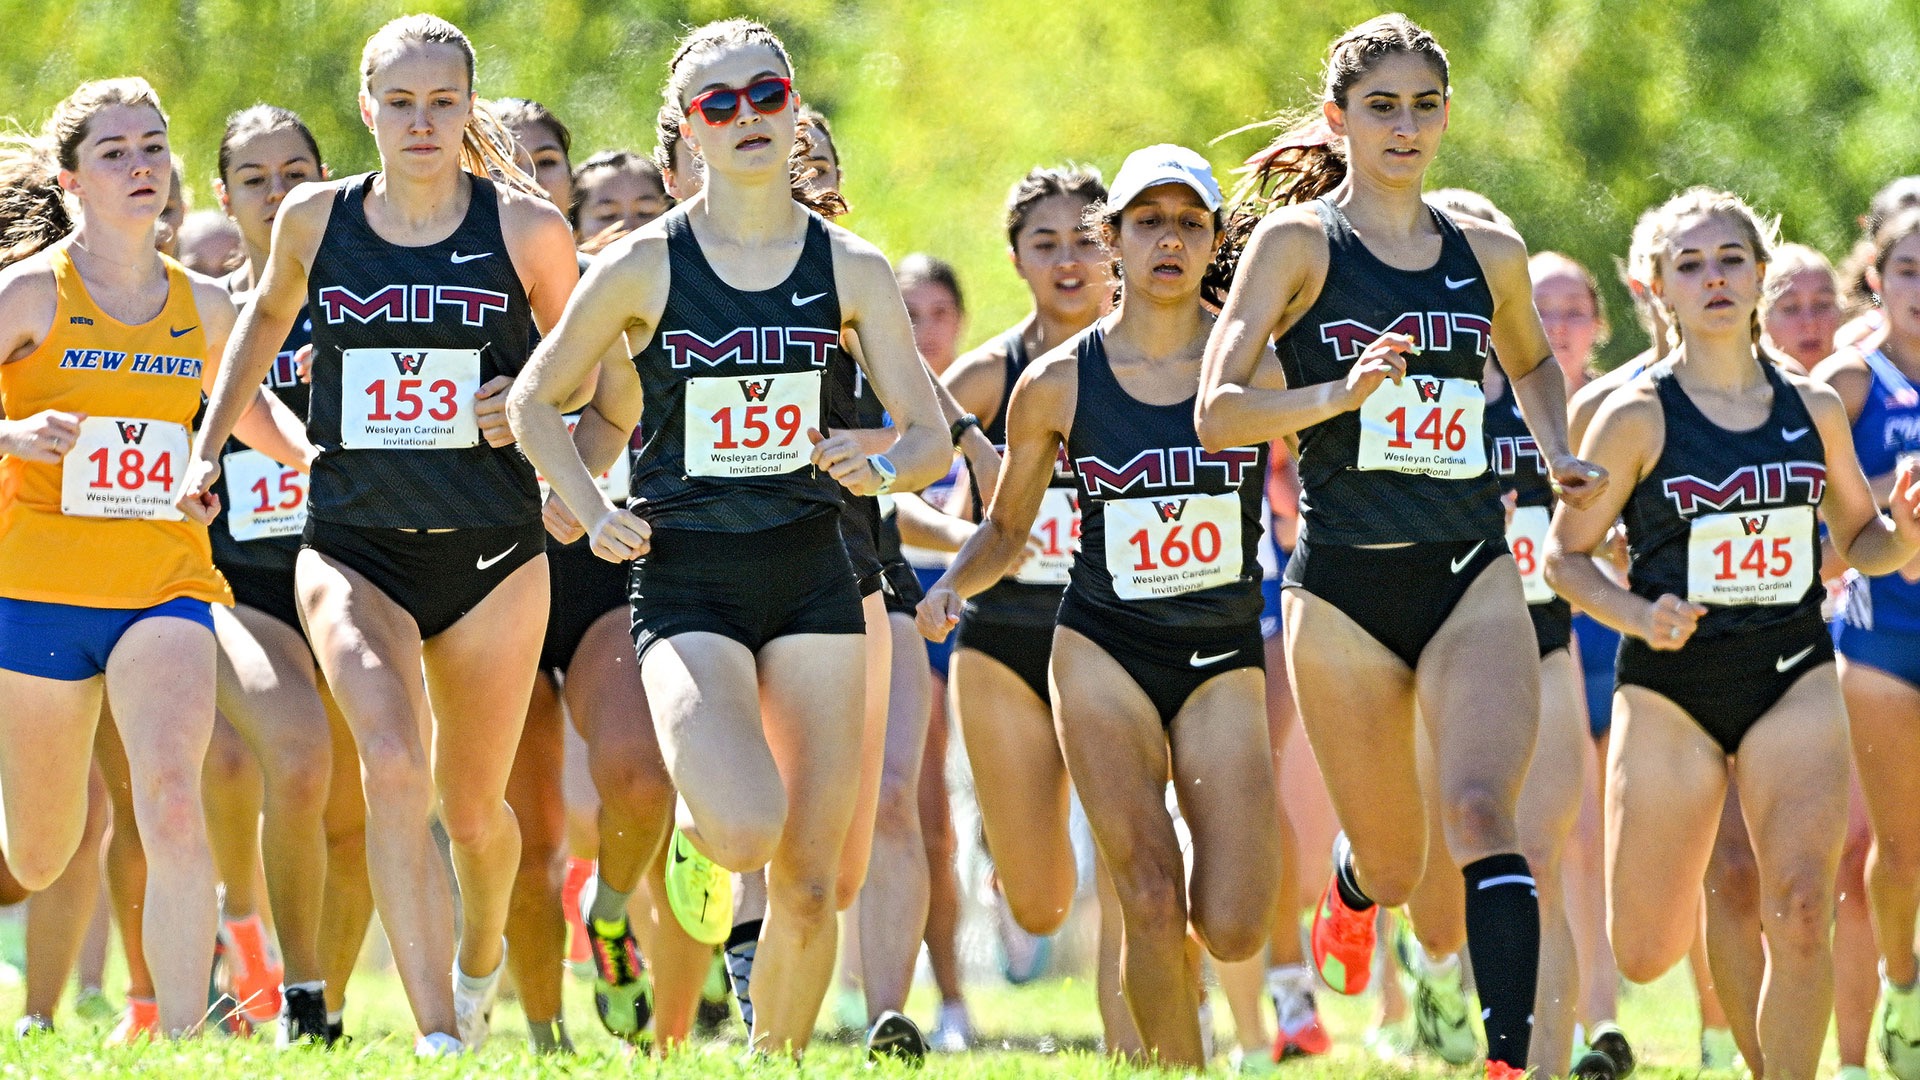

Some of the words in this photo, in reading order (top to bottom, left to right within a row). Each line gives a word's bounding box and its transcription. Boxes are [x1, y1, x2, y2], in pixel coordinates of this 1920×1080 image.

[319, 284, 508, 327] MIT
[662, 326, 839, 368] MIT
[1319, 312, 1492, 361] MIT
[59, 348, 127, 371] NEW
[130, 353, 203, 379] HAVEN
[364, 378, 458, 421] 153
[365, 425, 411, 436] Wesleyan
[414, 425, 455, 434] Cardinal
[383, 437, 436, 446] Invitational
[711, 404, 801, 449] 159
[1385, 407, 1467, 451] 146
[88, 447, 174, 492] 184
[711, 453, 757, 465] Wesleyan
[760, 451, 798, 462] Cardinal
[729, 464, 781, 475] Invitational
[1075, 447, 1259, 496] MIT
[1384, 452, 1431, 465] Wesleyan
[1433, 455, 1467, 465] Cardinal
[1400, 466, 1452, 477] Invitational
[86, 492, 132, 504] Wesleyan
[134, 494, 171, 505] Cardinal
[251, 470, 309, 513] 15
[1662, 460, 1827, 515] MIT
[103, 505, 155, 516] Invitational
[1128, 521, 1221, 571] 160
[1713, 537, 1793, 580] 145
[1132, 573, 1179, 585] Wesleyan
[1182, 566, 1221, 579] Cardinal
[1151, 581, 1204, 595] Invitational
[1713, 584, 1756, 594] Wesleyan
[1758, 581, 1792, 591] Cardinal
